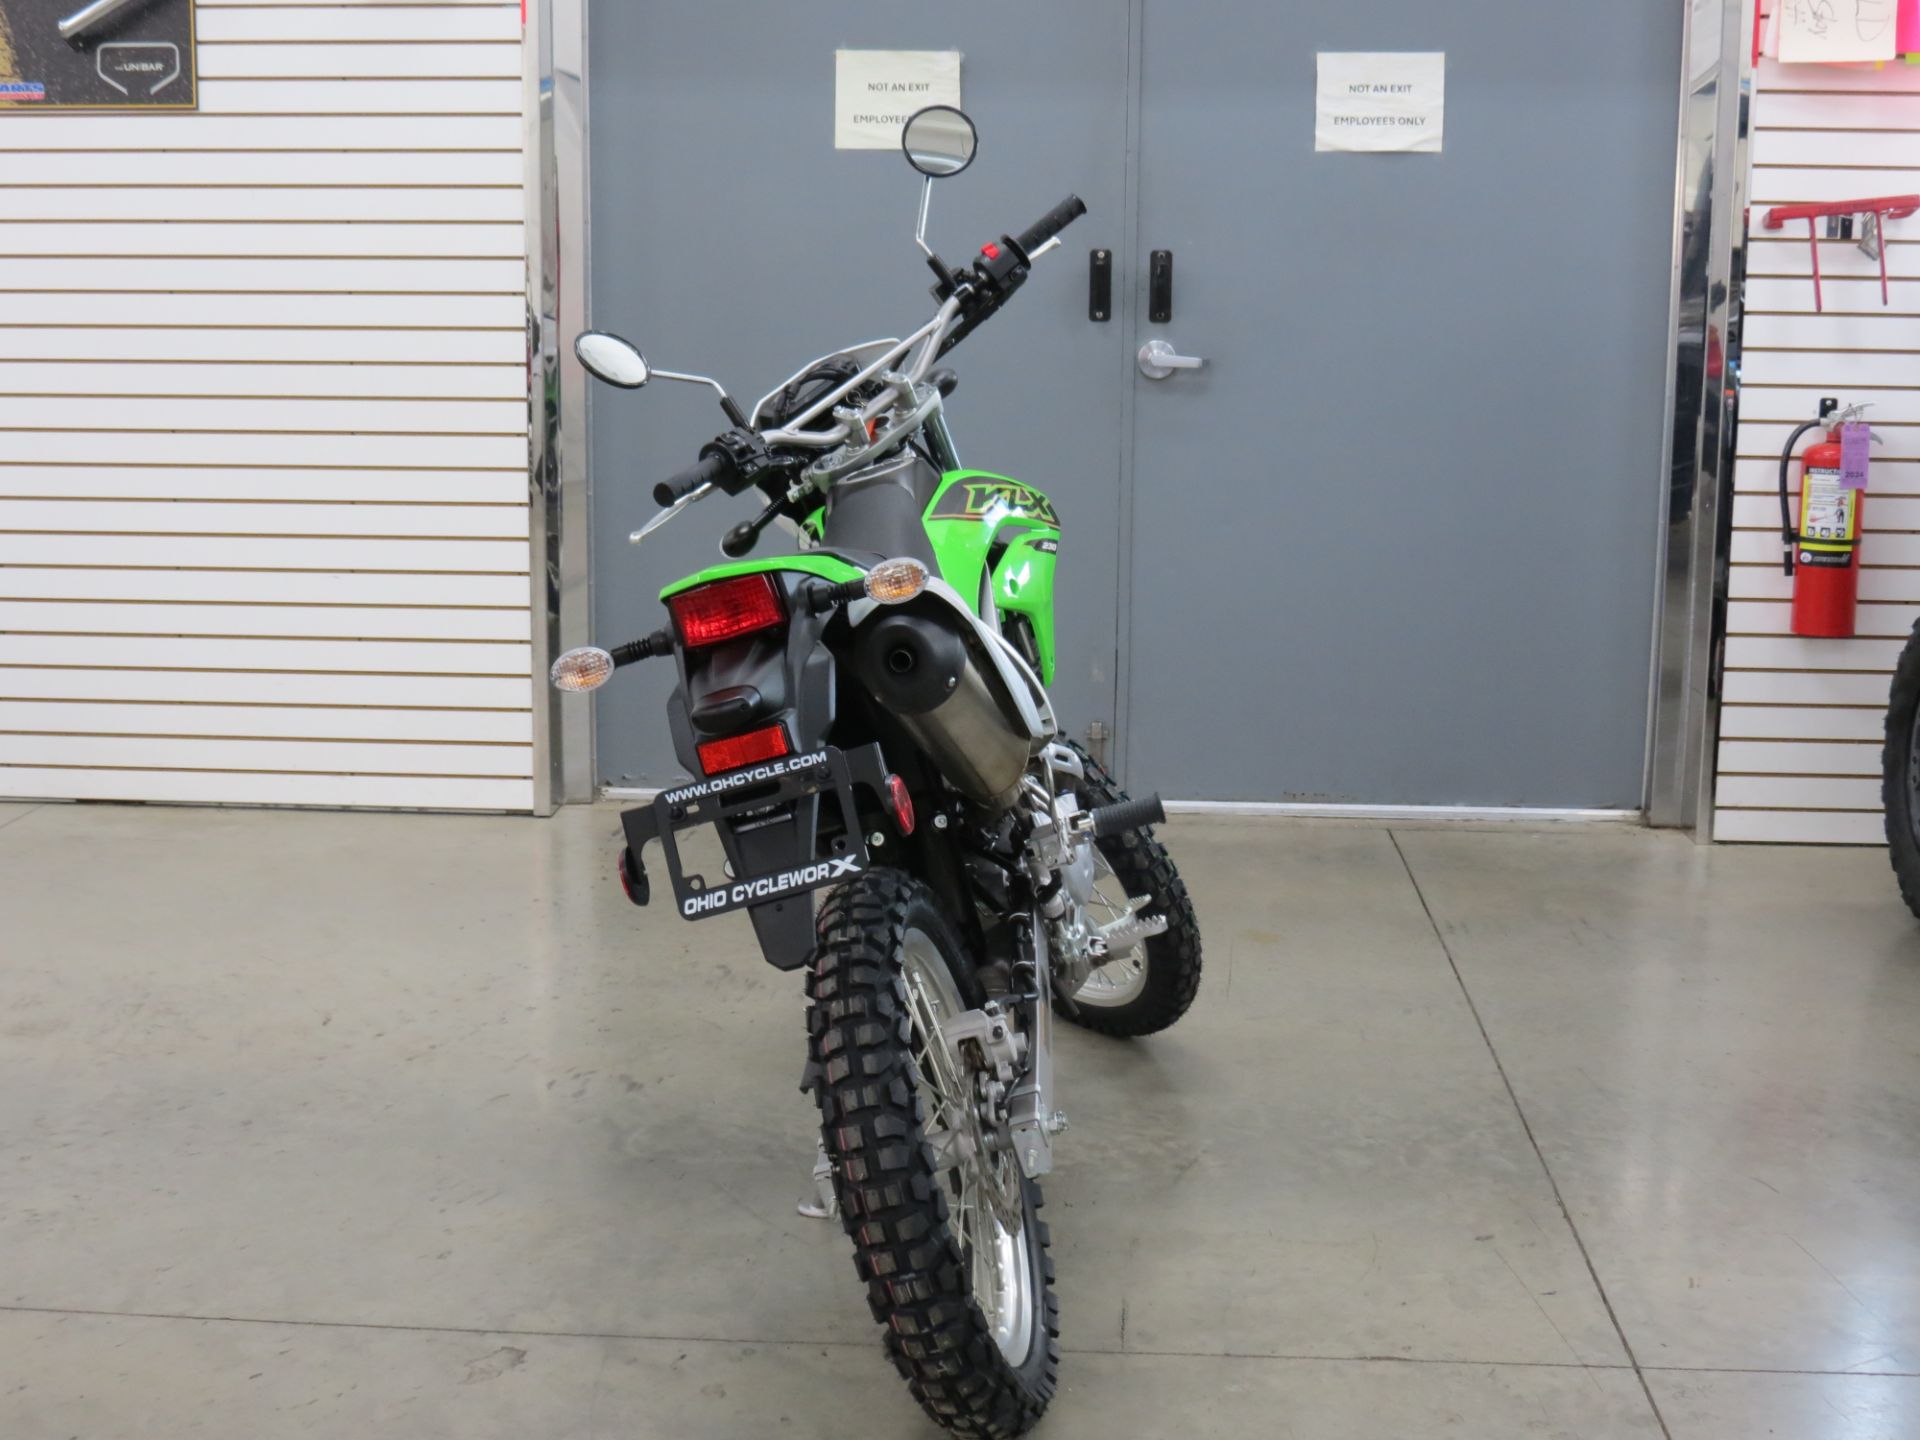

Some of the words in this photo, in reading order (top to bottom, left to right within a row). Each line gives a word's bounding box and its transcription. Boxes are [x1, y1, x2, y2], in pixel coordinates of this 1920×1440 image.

[867, 83, 888, 92] NOT
[891, 83, 906, 92] AN
[908, 83, 930, 92] EXIT
[1348, 84, 1370, 93] NOT
[1372, 84, 1388, 93] AN
[1390, 84, 1412, 93] EXIT
[1333, 116, 1396, 126] EMPLOYEES
[1398, 116, 1426, 126] ONLY
[664, 751, 828, 804] WWW.OHCYCLE.COM
[683, 890, 727, 915] OHIO
[731, 854, 862, 903] CYCLEWORX
